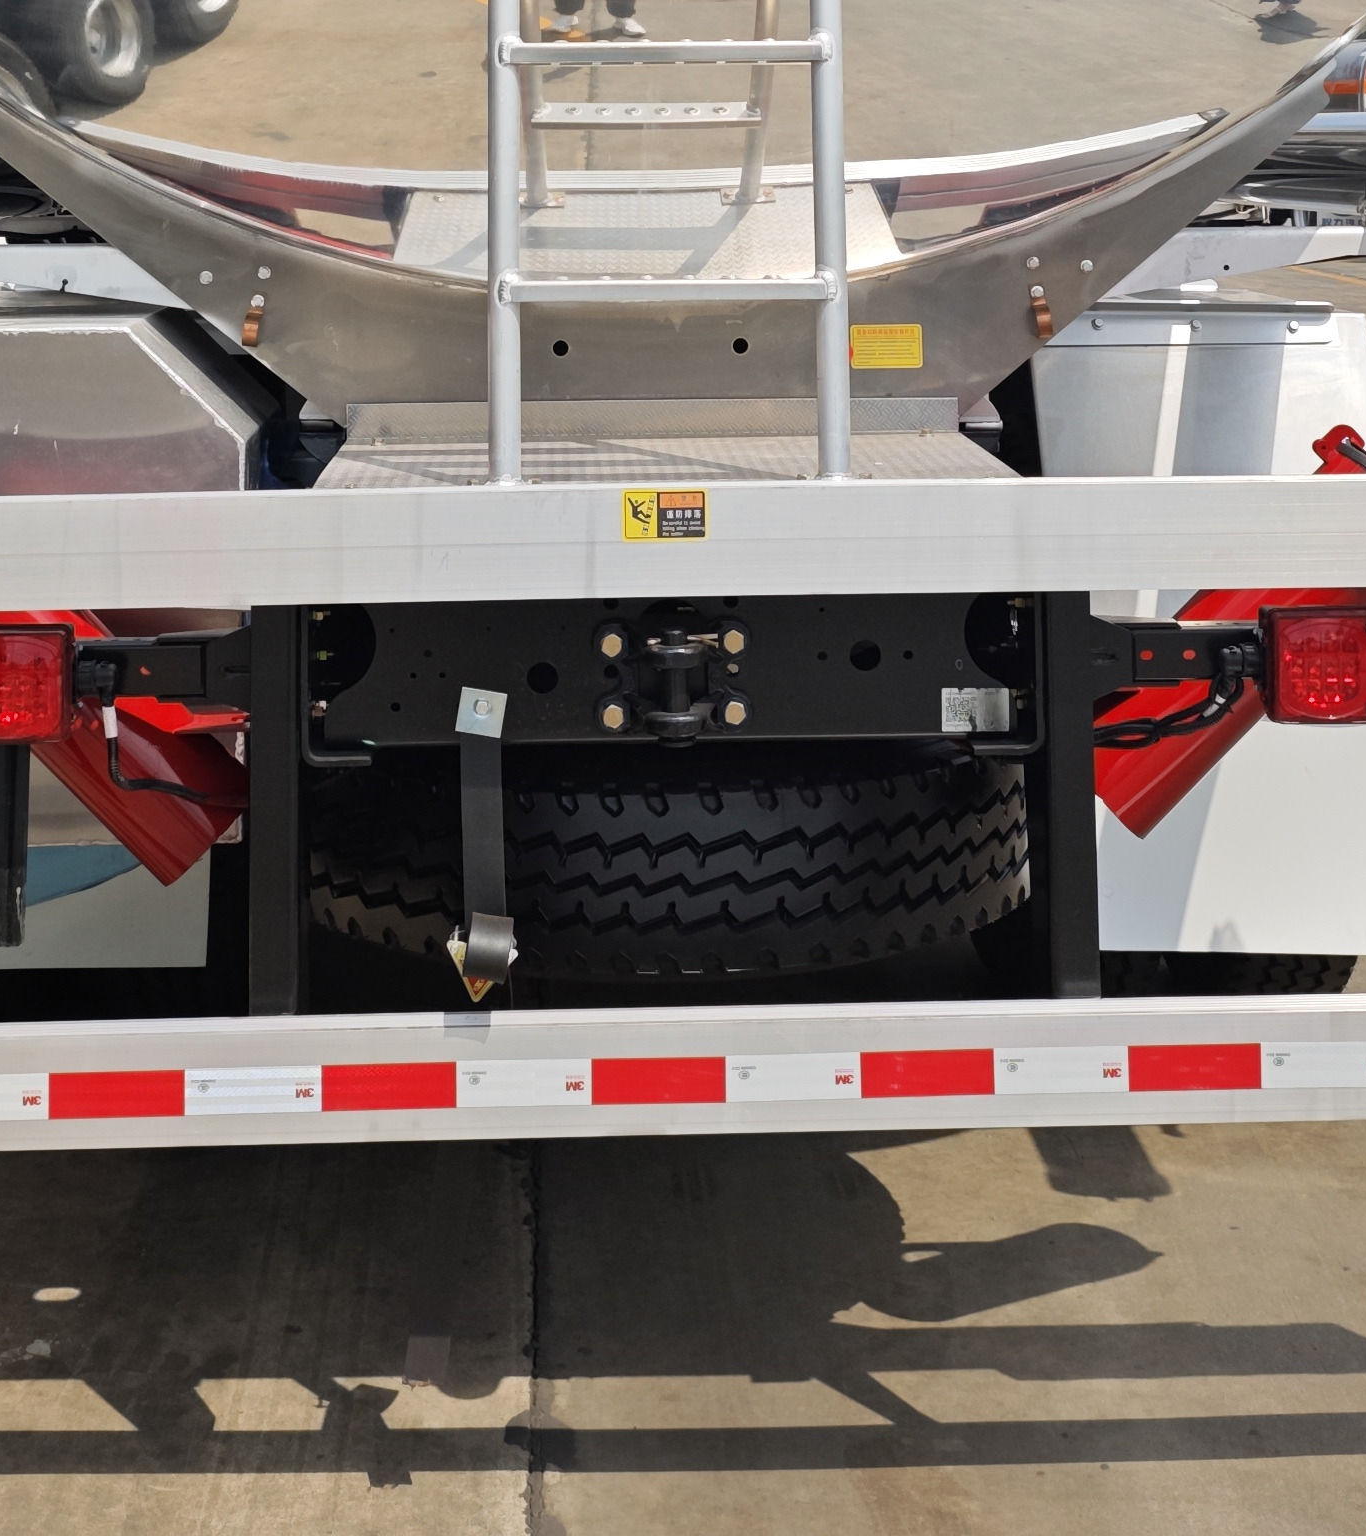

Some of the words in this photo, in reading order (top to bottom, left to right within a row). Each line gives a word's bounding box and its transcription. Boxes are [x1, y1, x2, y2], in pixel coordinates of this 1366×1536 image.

[1102, 1068, 1122, 1078] 3M
[835, 1074, 854, 1085] 3M
[565, 1081, 585, 1091] 3M
[295, 1088, 315, 1099] 3M
[22, 1095, 42, 1106] 3M
